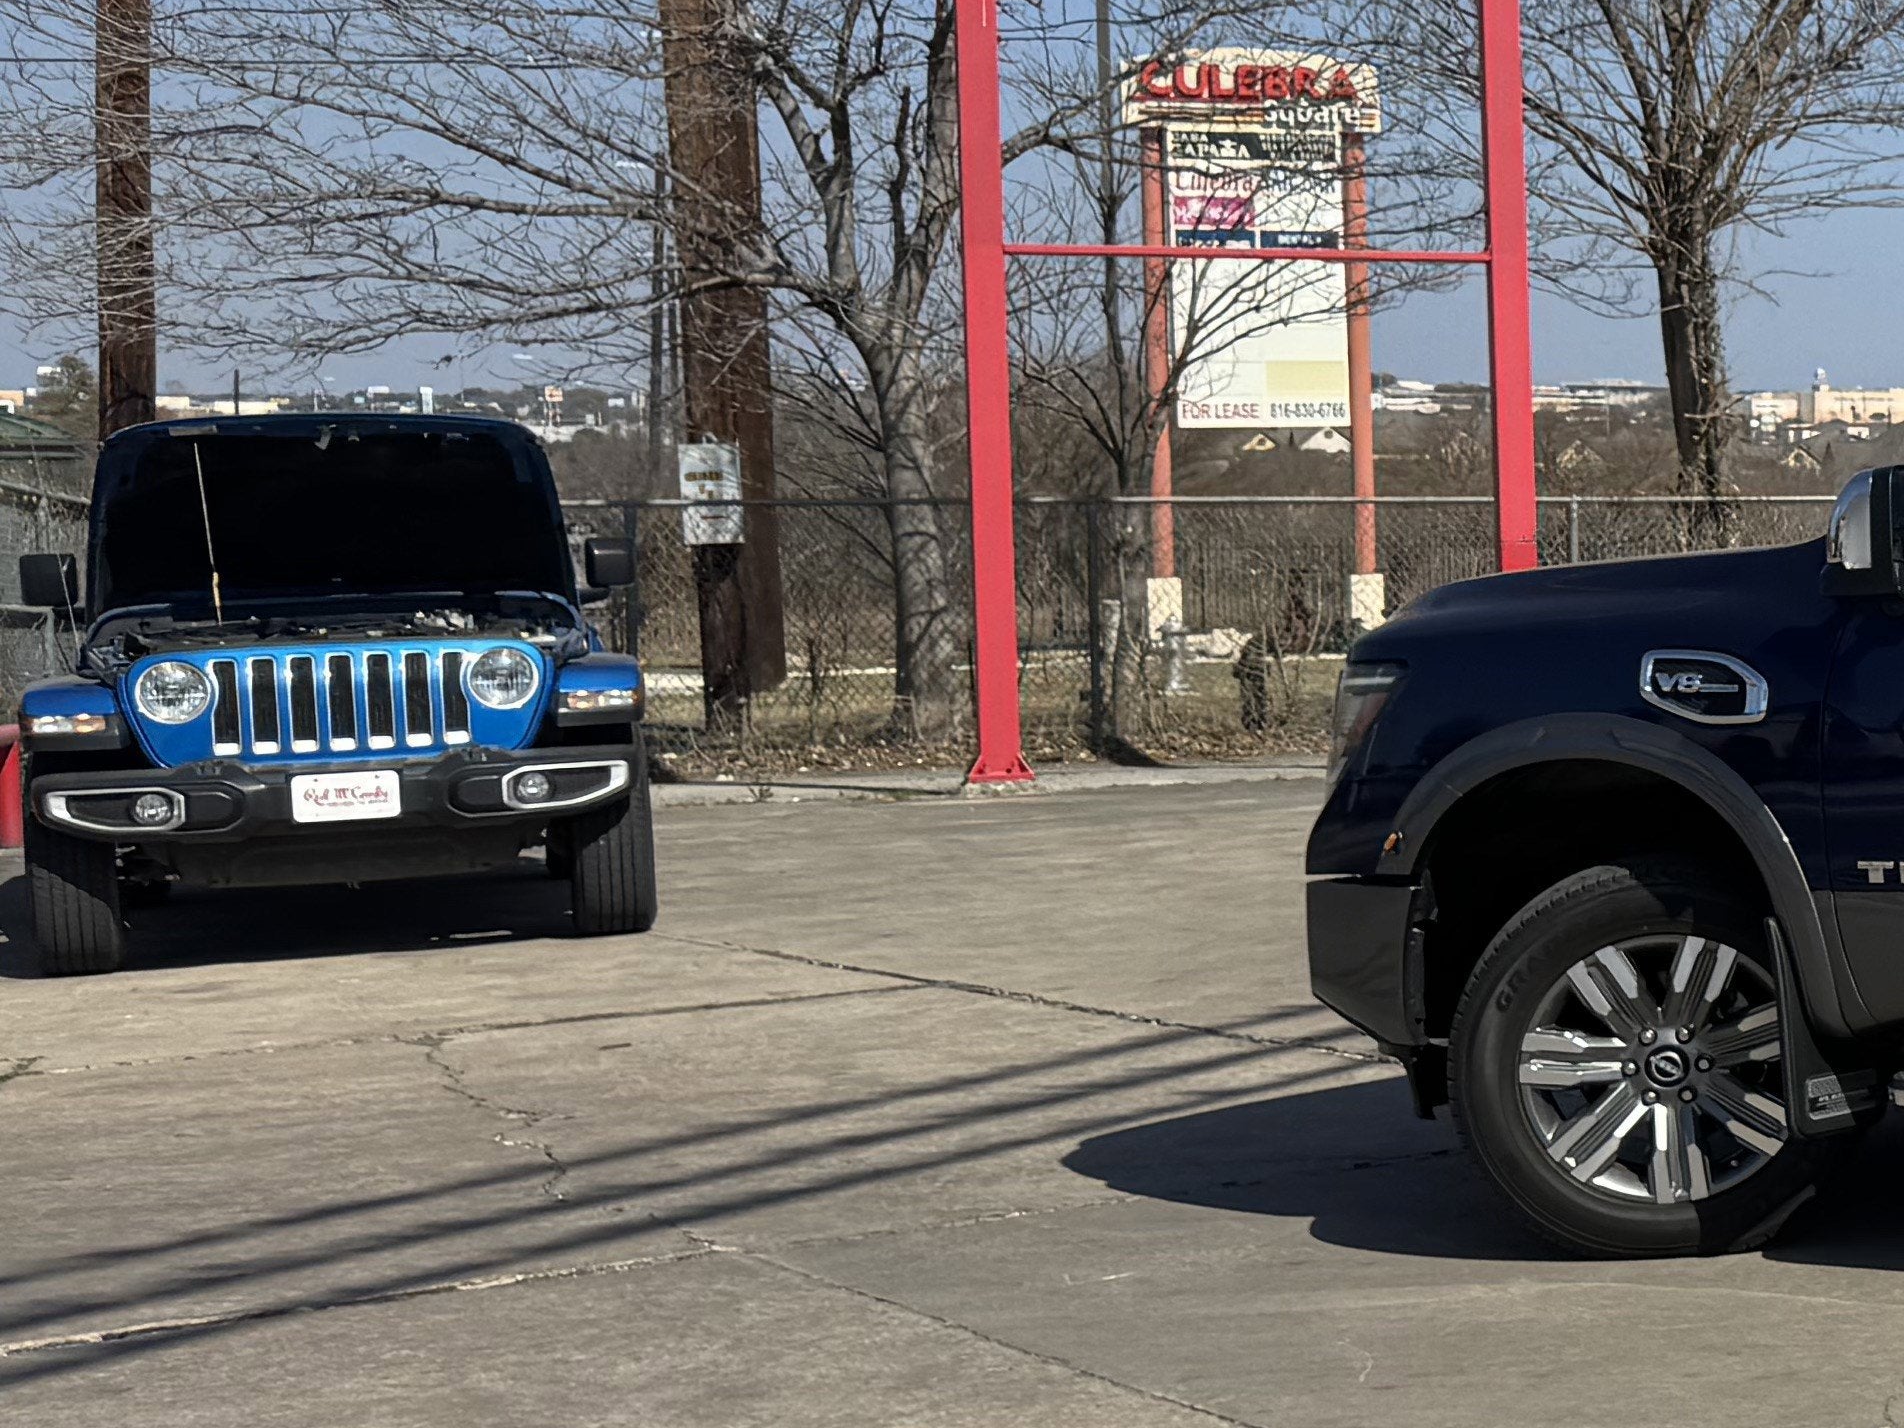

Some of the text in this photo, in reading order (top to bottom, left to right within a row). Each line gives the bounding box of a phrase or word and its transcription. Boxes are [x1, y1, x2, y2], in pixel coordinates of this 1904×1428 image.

[1140, 61, 1358, 98] CULEBRA
[1182, 403, 1211, 419] FOR
[1214, 403, 1260, 419] LEASE
[1655, 671, 1702, 694] V8
